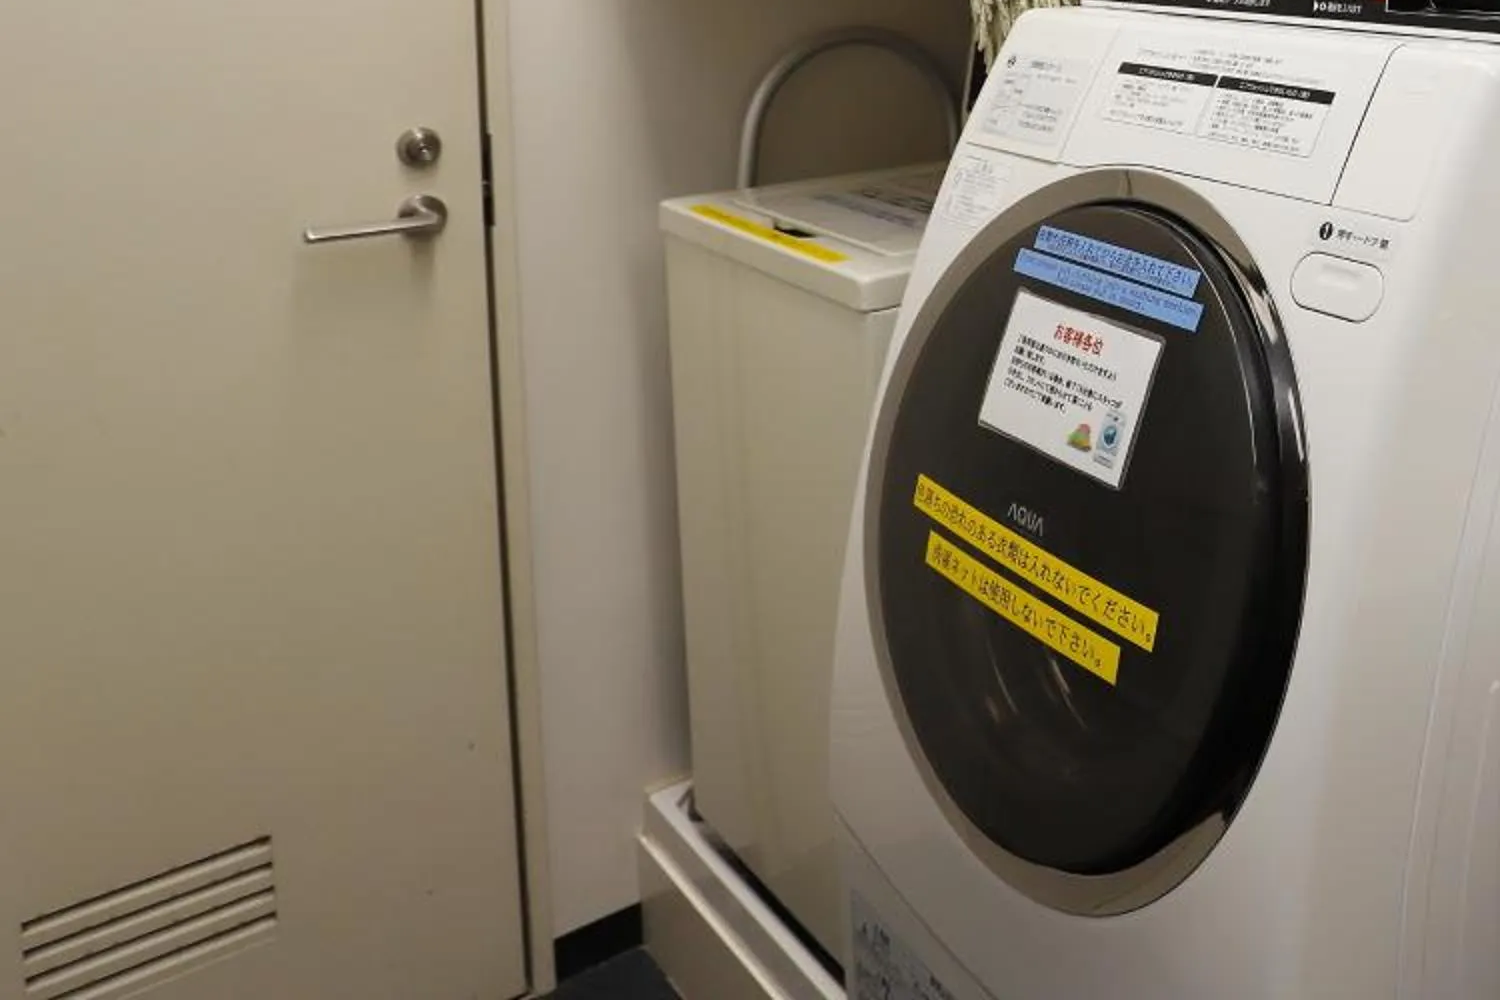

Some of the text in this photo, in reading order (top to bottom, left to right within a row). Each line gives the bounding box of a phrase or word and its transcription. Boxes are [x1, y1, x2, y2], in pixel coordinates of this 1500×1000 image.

[1053, 324, 1104, 356] お客様各位
[1006, 502, 1045, 538] AQUA
